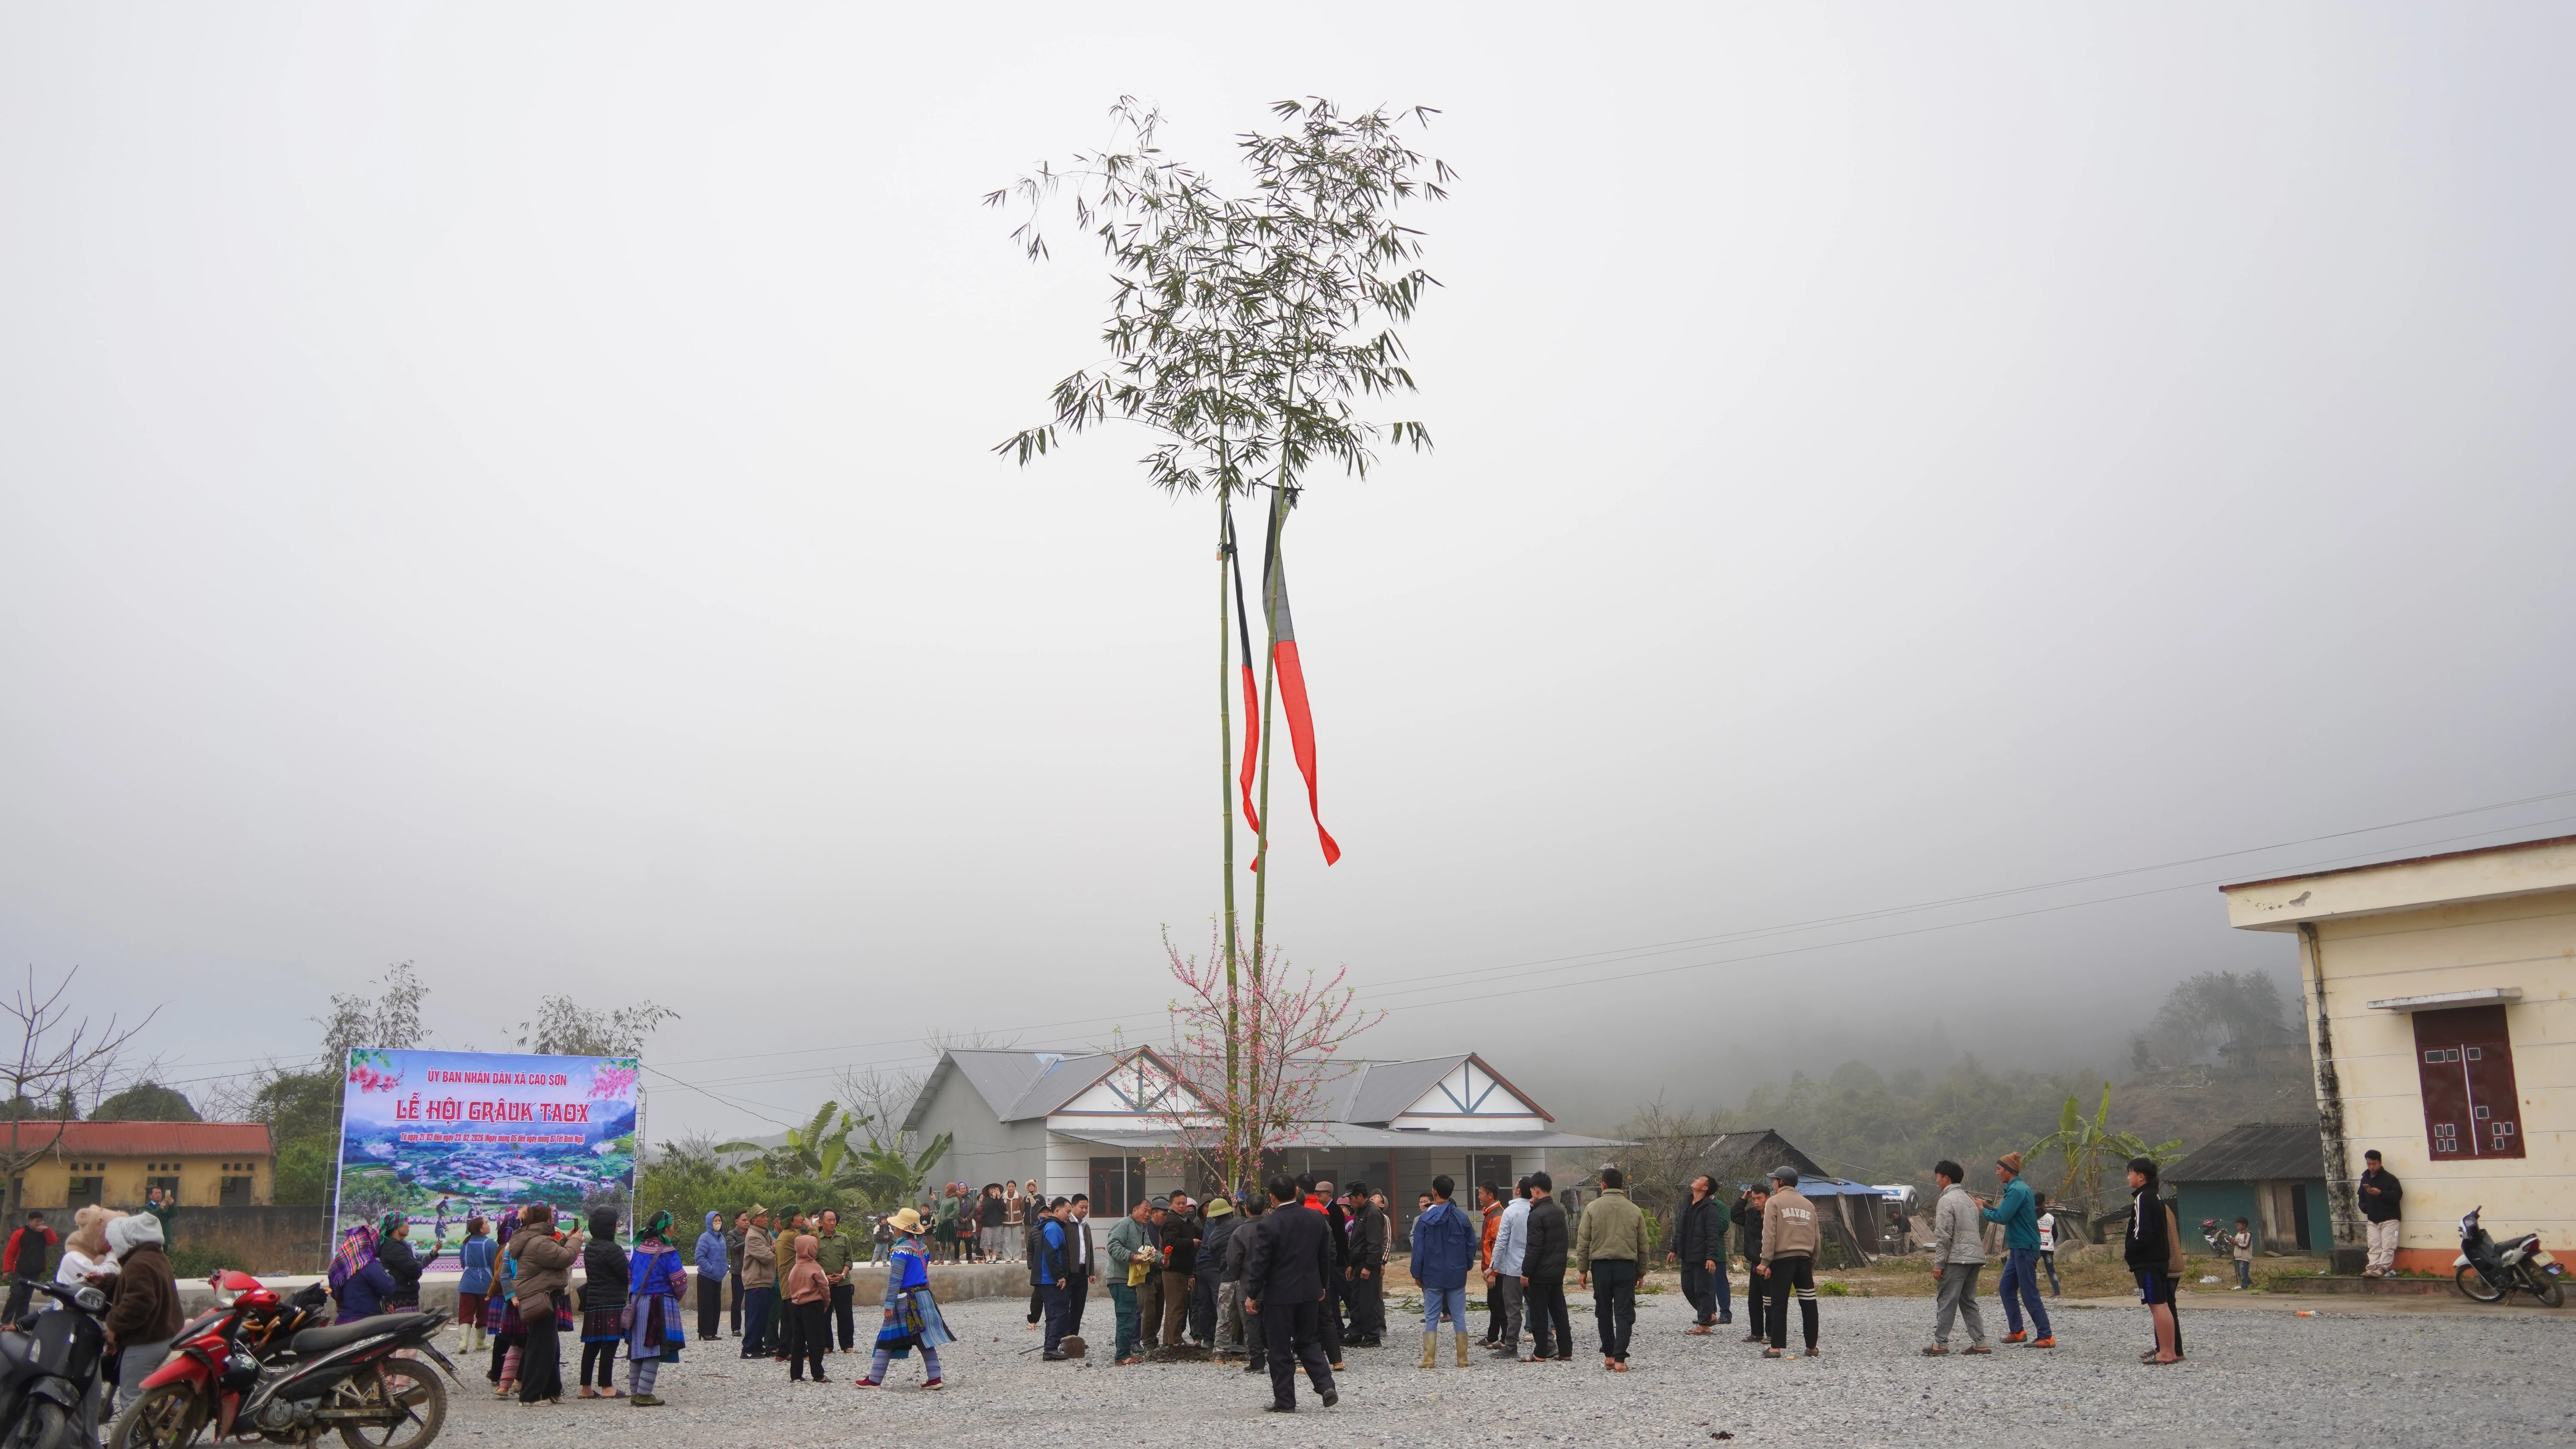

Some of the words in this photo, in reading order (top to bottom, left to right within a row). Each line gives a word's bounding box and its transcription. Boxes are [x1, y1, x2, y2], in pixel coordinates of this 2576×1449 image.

[428, 1067, 440, 1082] ỦY
[443, 1071, 462, 1083] BAN
[465, 1070, 491, 1084] NHÂN
[493, 1070, 511, 1084] DÂN
[514, 1071, 526, 1085] XÃ
[529, 1073, 546, 1085] CAO
[549, 1073, 567, 1086] SƠN
[395, 1092, 422, 1119] LỄ
[426, 1097, 463, 1125] HỘI
[469, 1098, 536, 1123] GRÂUK
[541, 1103, 592, 1123] TAOX
[408, 1134, 419, 1142] ngày
[443, 1134, 454, 1143] ngày
[1781, 1207, 1810, 1220] MAYBE
